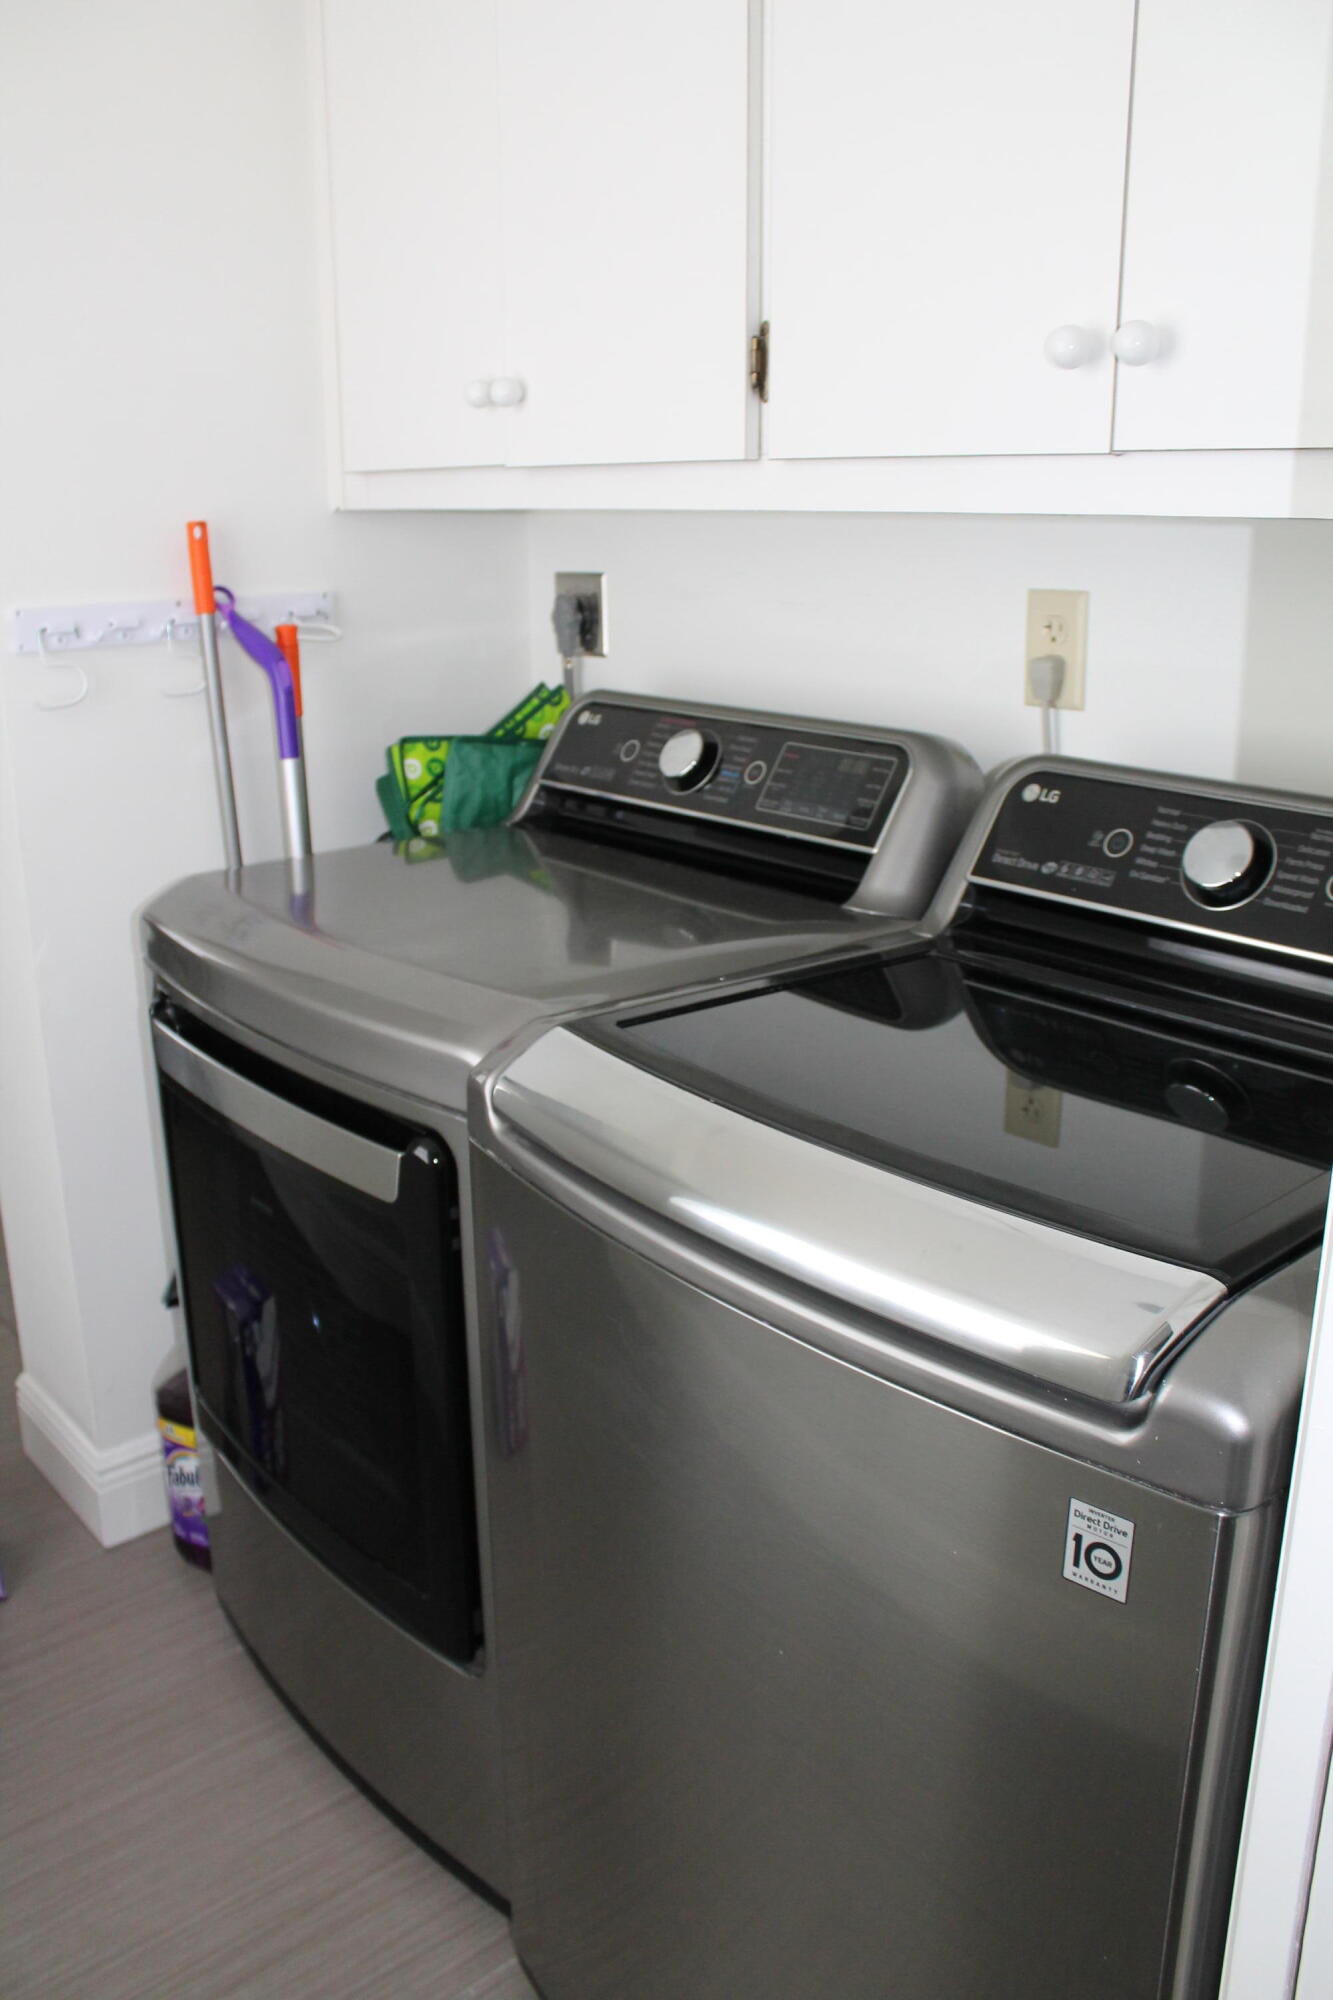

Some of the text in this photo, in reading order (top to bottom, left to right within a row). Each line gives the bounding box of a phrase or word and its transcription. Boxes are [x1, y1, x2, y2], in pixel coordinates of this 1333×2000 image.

[1074, 1509, 1129, 1538] Direct Drive
[1087, 1524, 1114, 1538] MOTOR
[1073, 1532, 1123, 1581] 10
[1093, 1555, 1113, 1569] YEAR
[1072, 1571, 1118, 1594] WARRANTY
